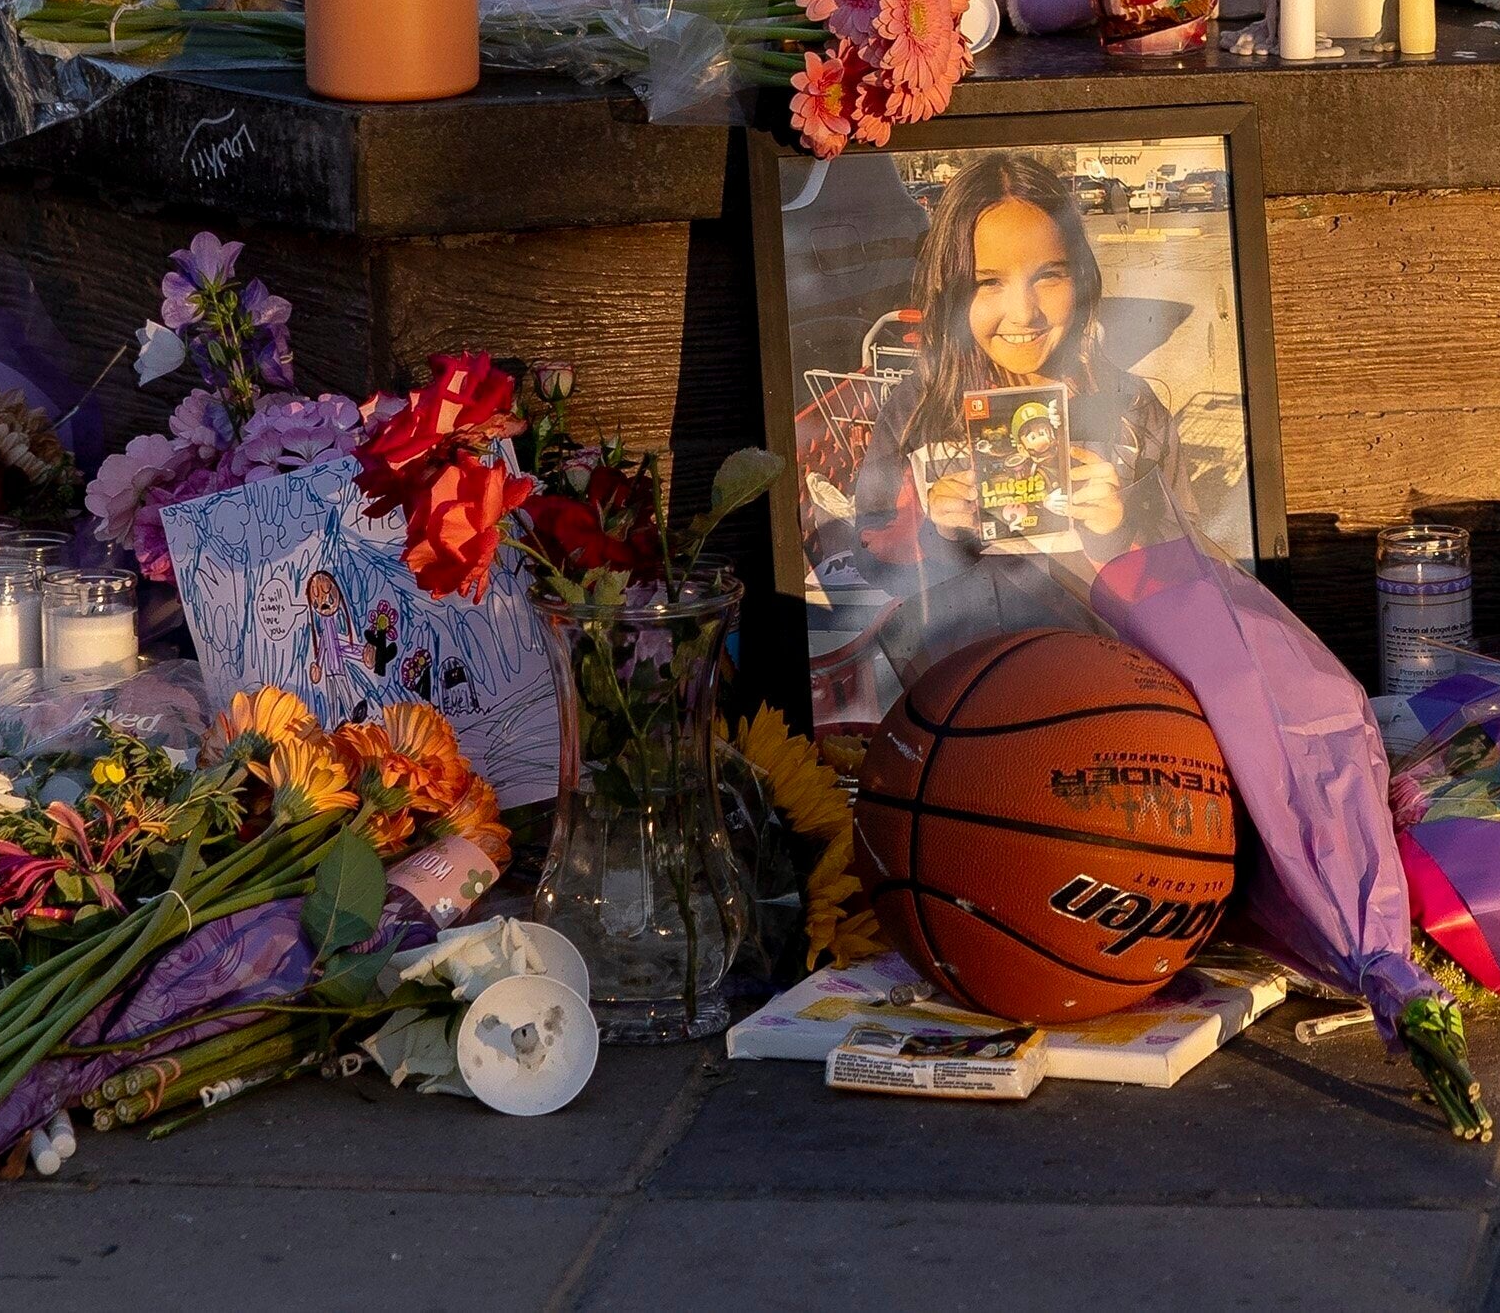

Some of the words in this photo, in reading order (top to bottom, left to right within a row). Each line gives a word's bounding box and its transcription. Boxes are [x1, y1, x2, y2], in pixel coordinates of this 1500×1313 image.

[1098, 152, 1138, 165] verizon
[981, 475, 1047, 499] Luigi's
[348, 501, 407, 532] frie
[268, 588, 283, 602] will
[260, 603, 286, 615] always
[263, 614, 280, 625] love
[411, 852, 454, 883] OOM
[1132, 871, 1197, 894] COURT
